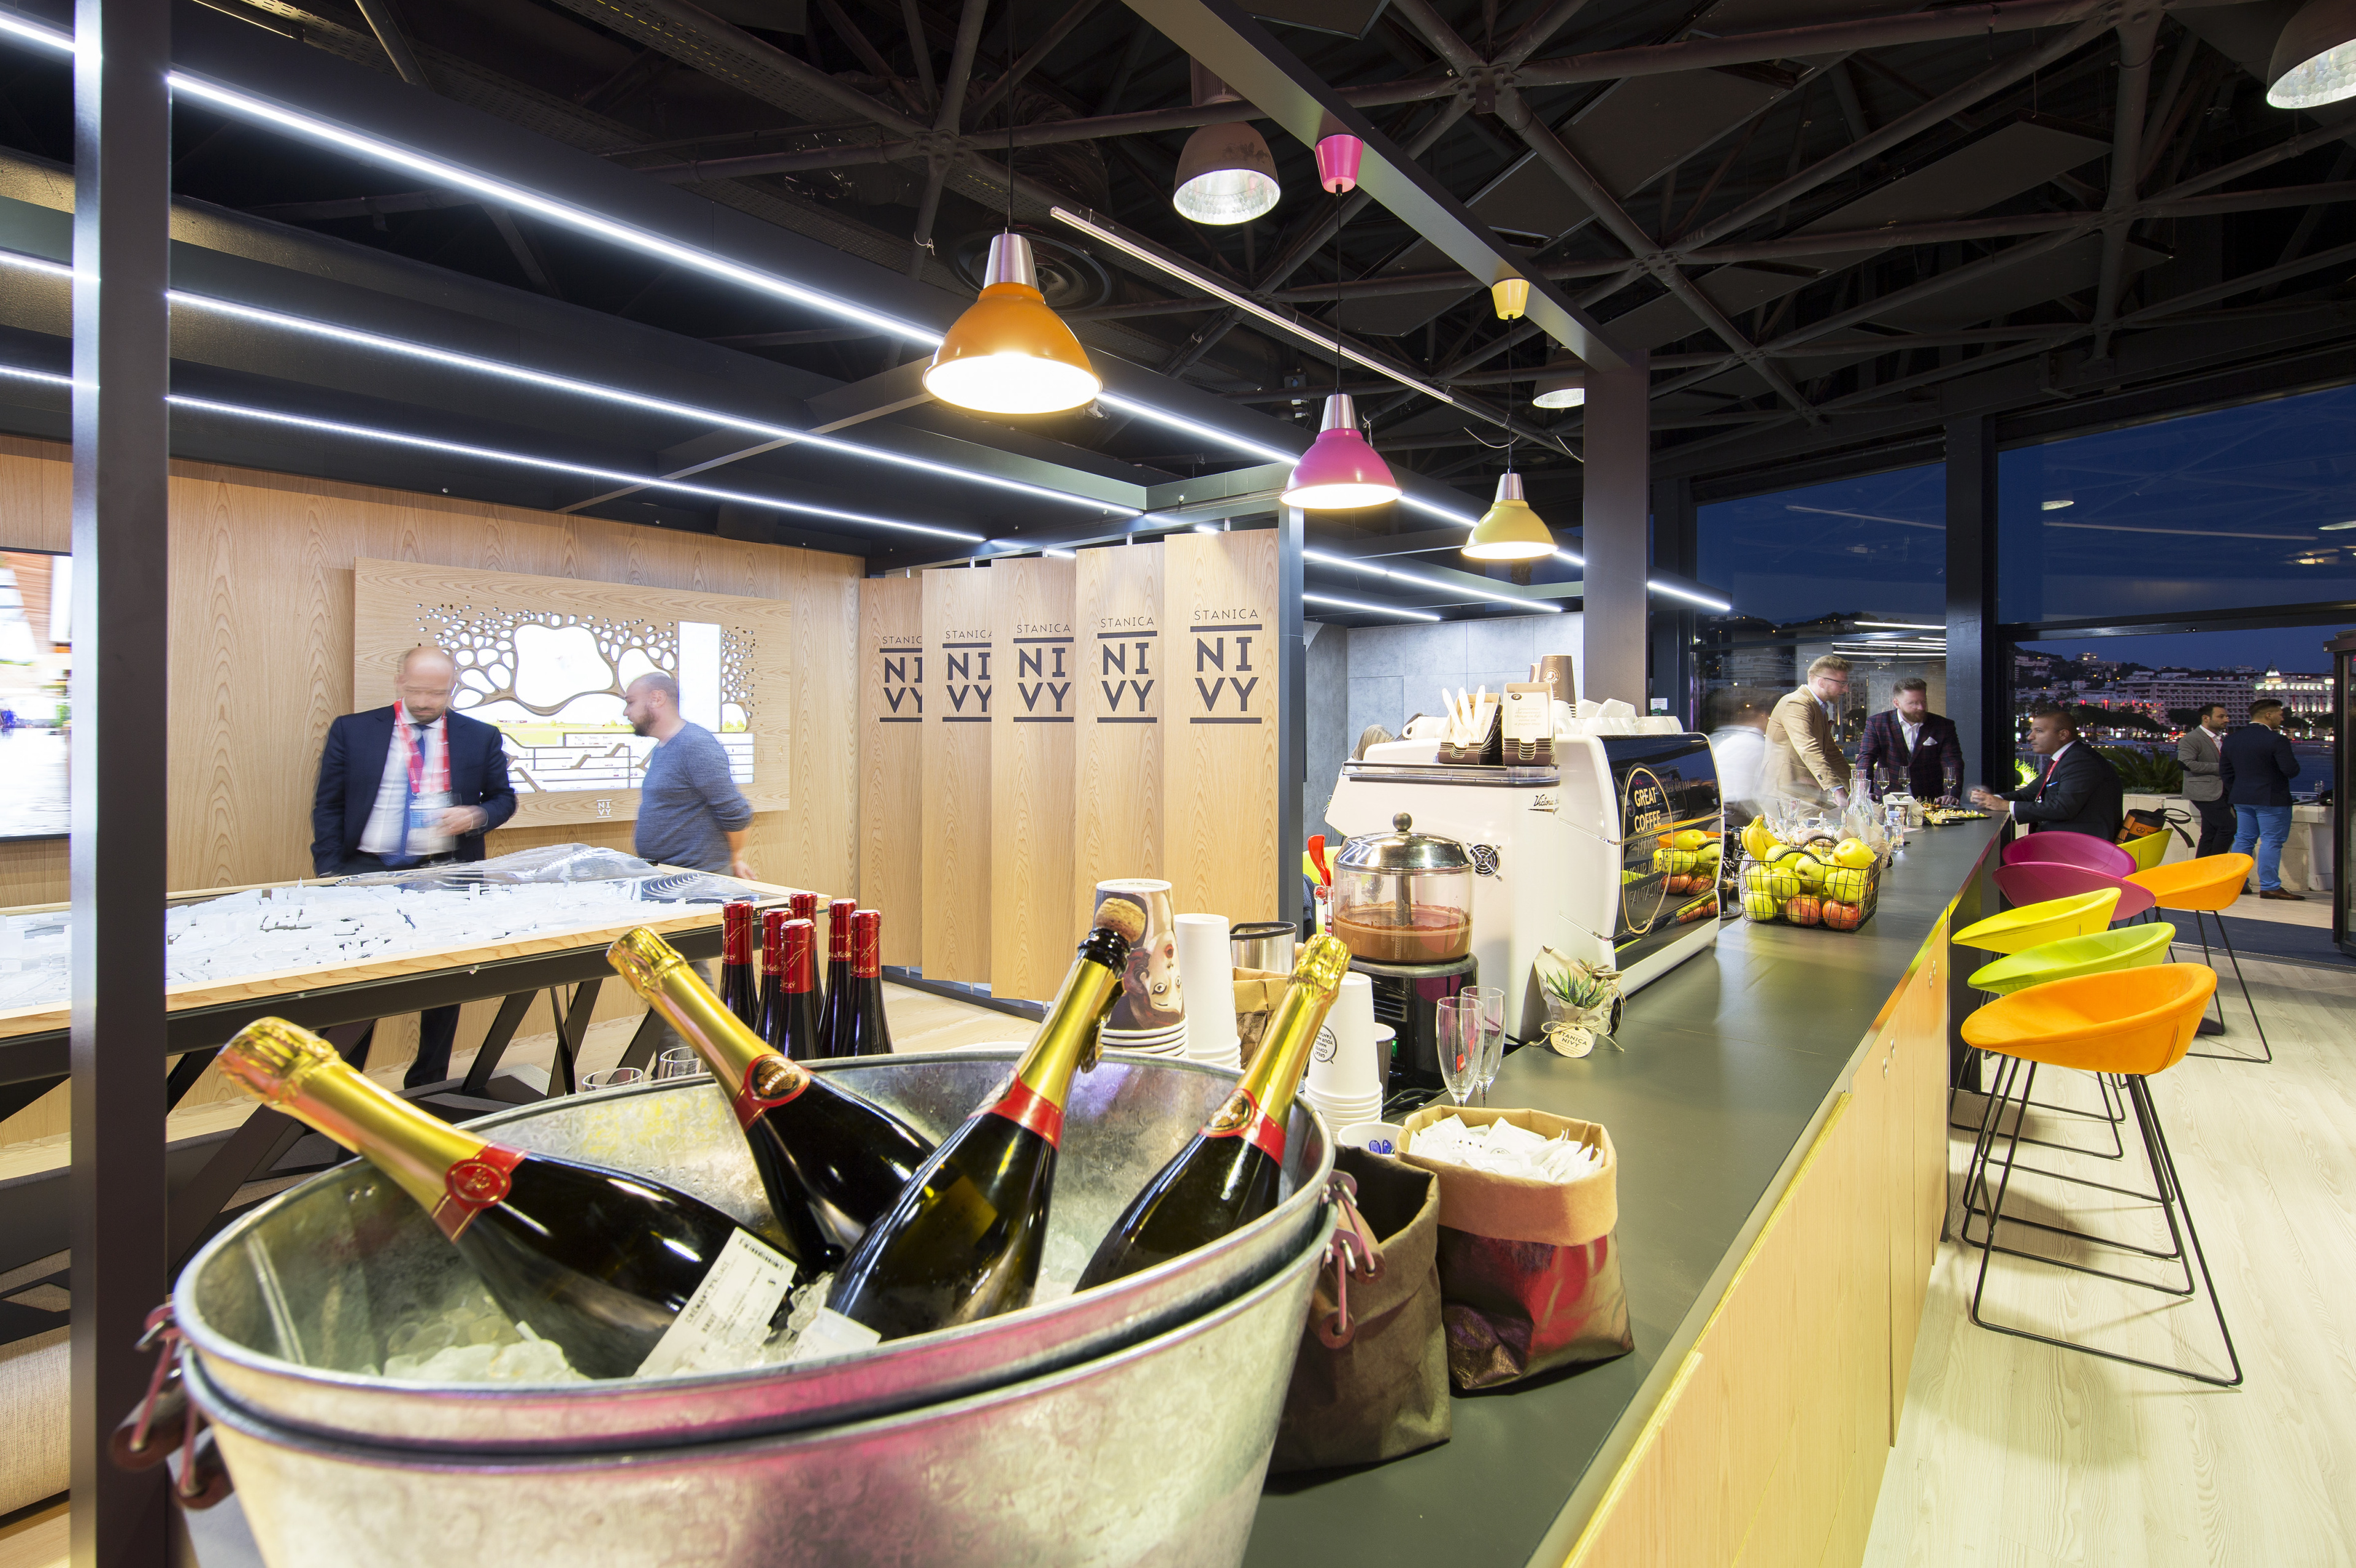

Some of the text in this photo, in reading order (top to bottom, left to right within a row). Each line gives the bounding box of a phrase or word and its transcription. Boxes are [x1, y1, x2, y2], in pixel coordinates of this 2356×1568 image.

[1101, 617, 1154, 628] STANICA
[1194, 609, 1258, 620] STANICA
[1017, 623, 1071, 633] STANICA
[948, 652, 990, 680] NI
[1019, 647, 1065, 677] NI
[1103, 642, 1149, 675] NI
[1197, 637, 1252, 672] NI
[946, 685, 992, 712] VY
[1017, 682, 1071, 712] VY
[1101, 680, 1155, 712] VY
[1195, 677, 1260, 712] VY
[1634, 787, 1657, 807] GREAT
[1634, 810, 1661, 832] COFFEE
[1638, 834, 1660, 857] MAKES
[1627, 862, 1647, 885] YOUR
[1628, 878, 1663, 908] FANTASTIC
[1558, 1031, 1587, 1046] STANICA
[1561, 1038, 1580, 1047] NIVY
